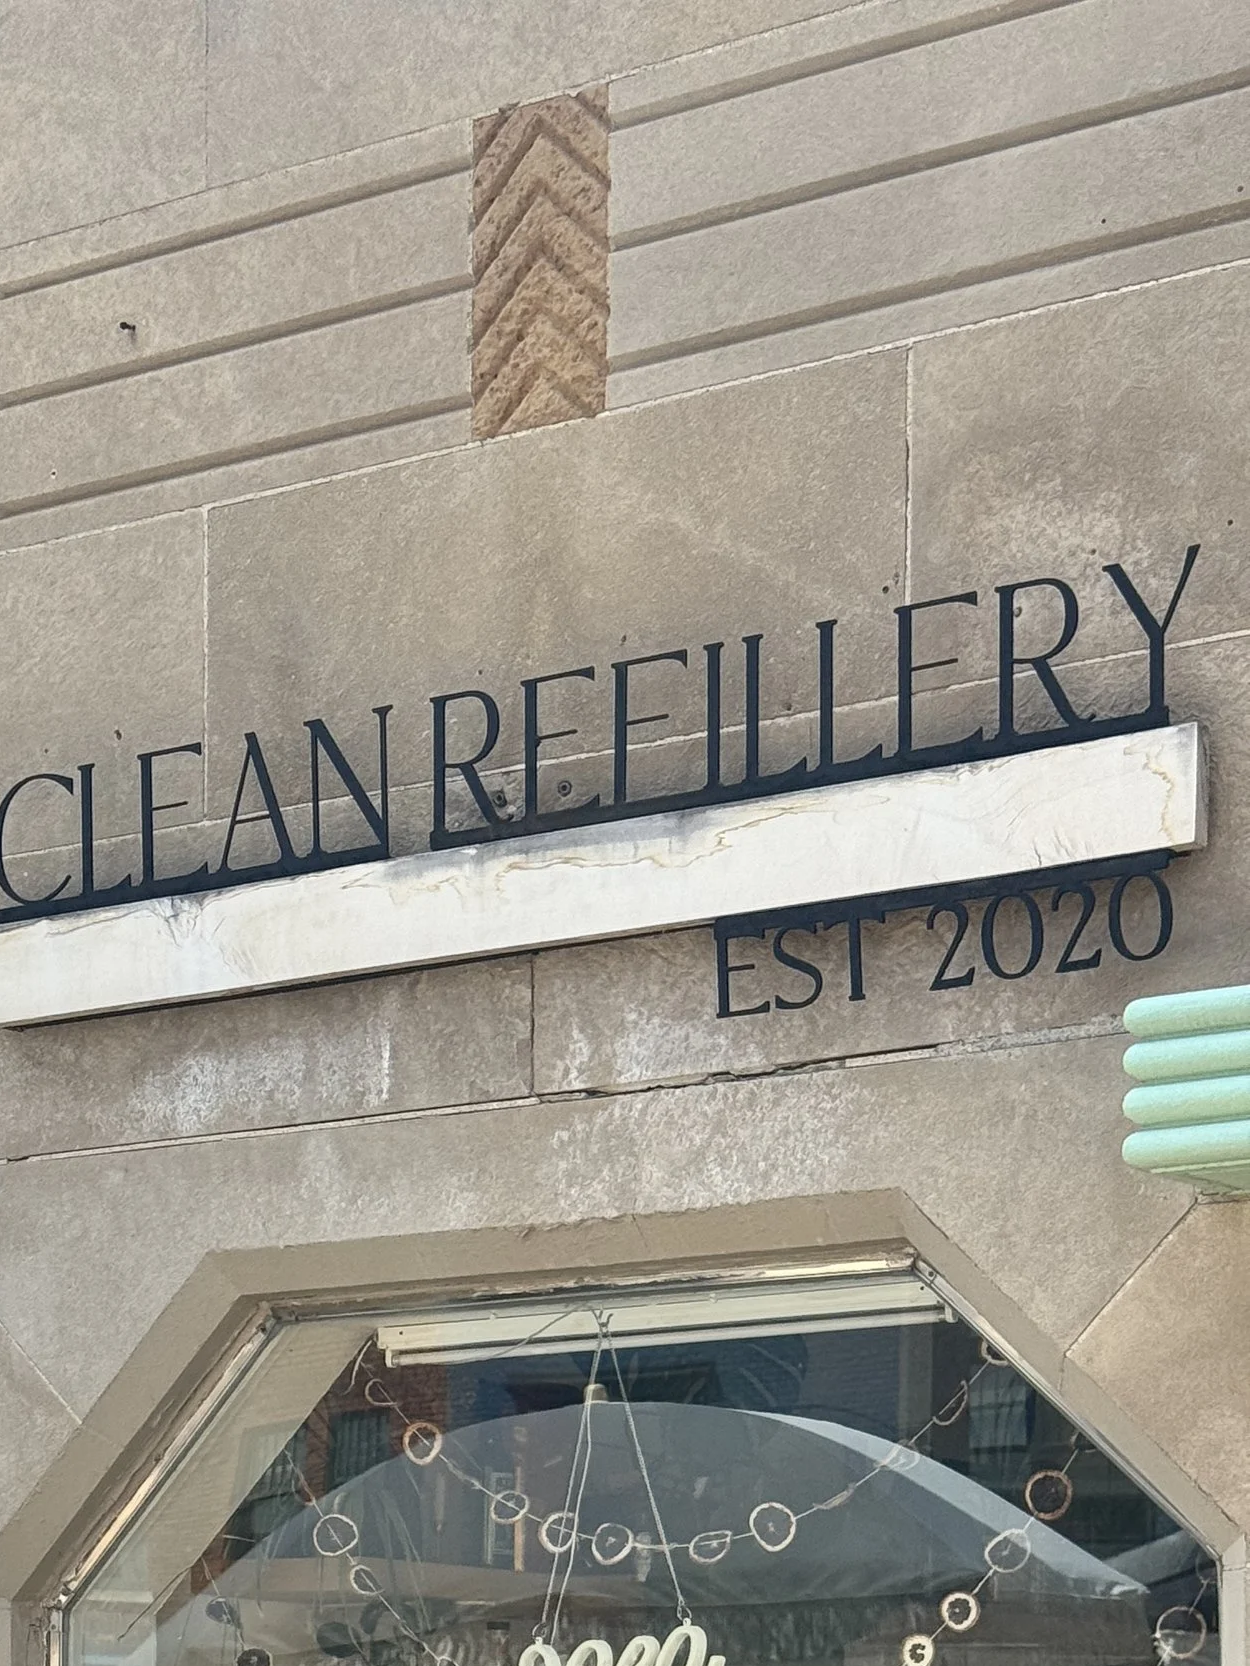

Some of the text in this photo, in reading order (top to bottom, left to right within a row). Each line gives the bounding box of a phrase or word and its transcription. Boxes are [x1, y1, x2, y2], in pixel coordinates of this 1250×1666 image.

[430, 544, 1200, 842] REFILLERY
[713, 872, 1174, 1020] EST 2020
